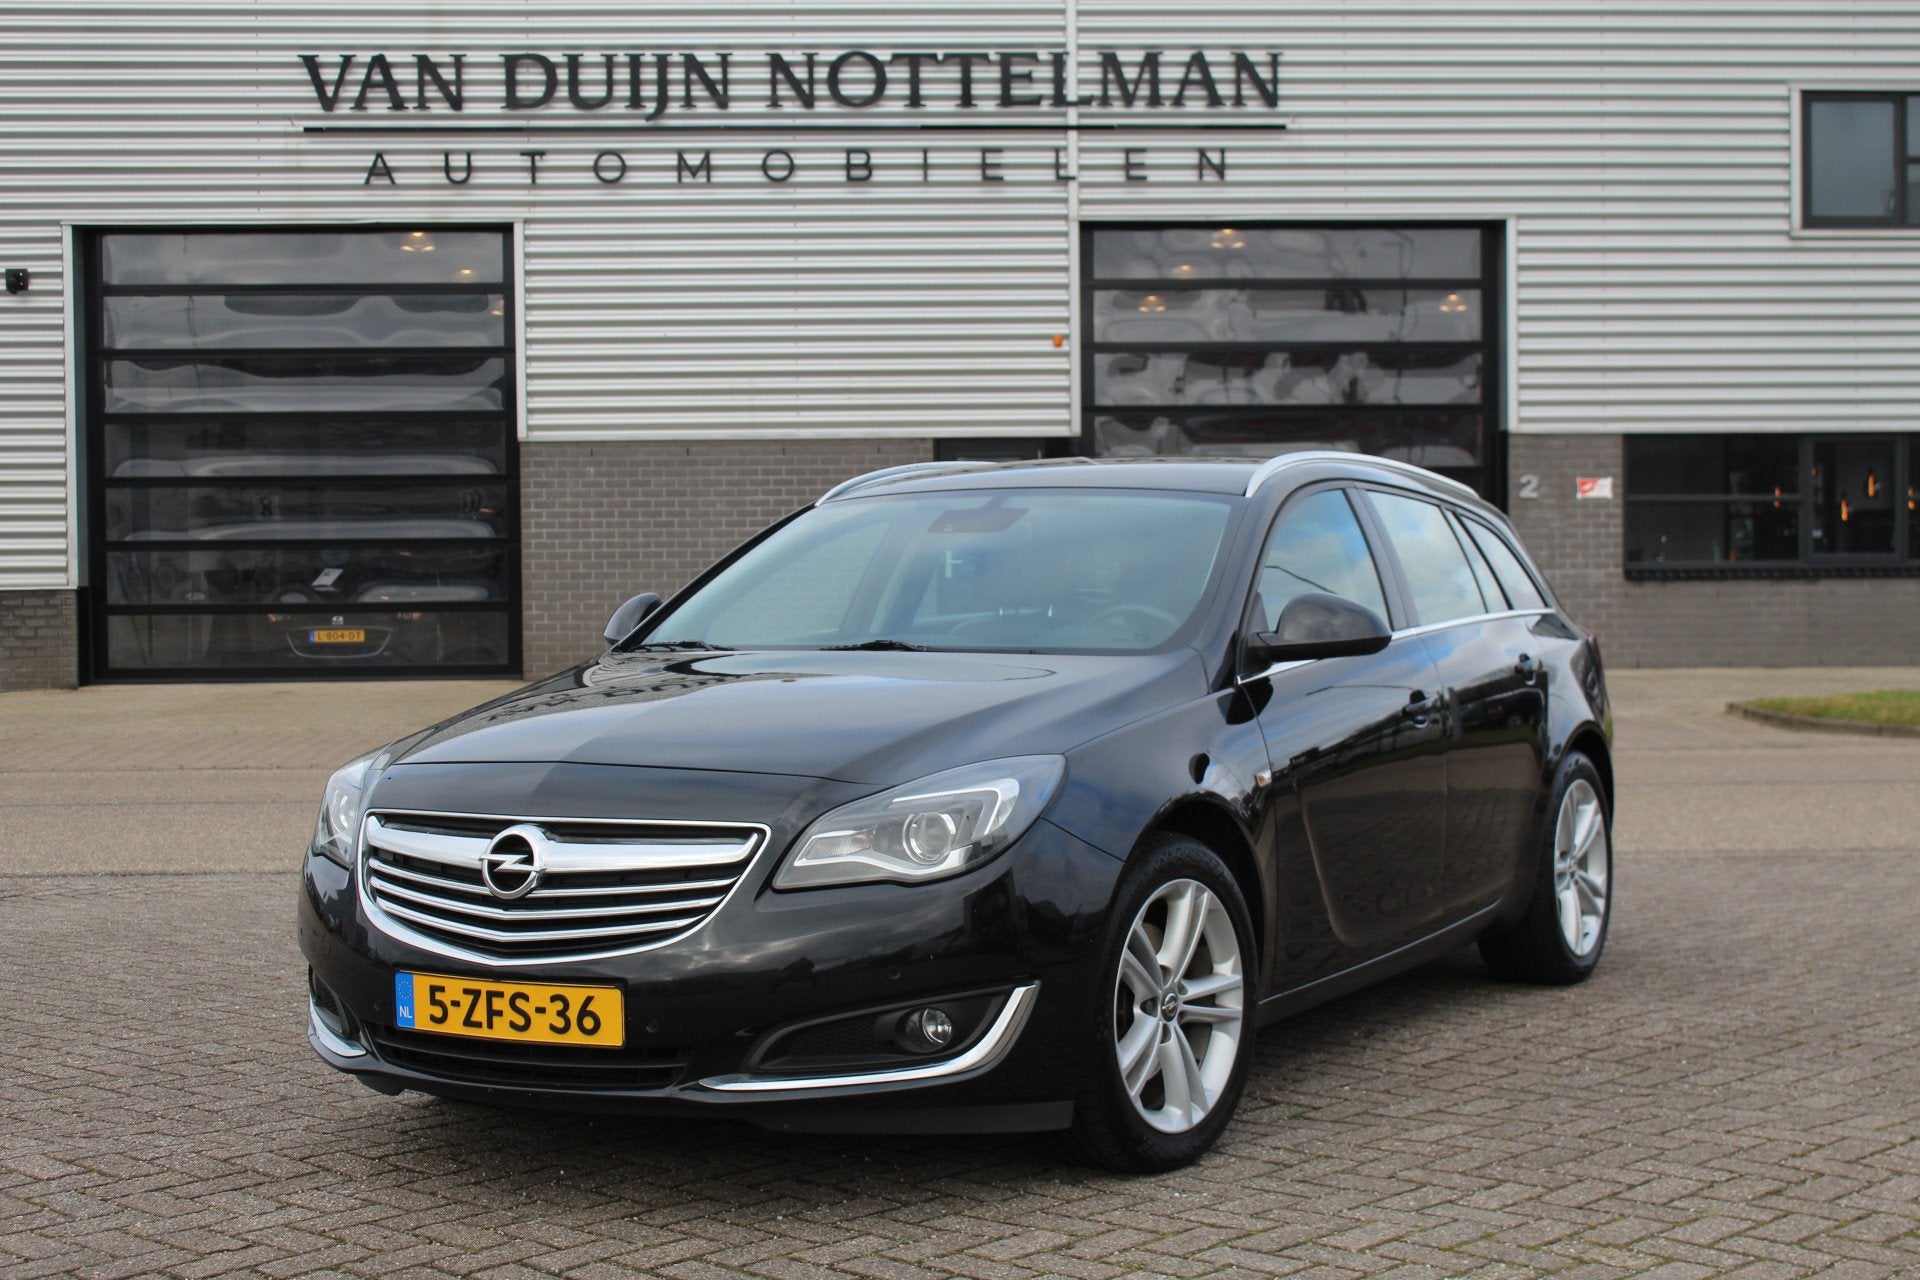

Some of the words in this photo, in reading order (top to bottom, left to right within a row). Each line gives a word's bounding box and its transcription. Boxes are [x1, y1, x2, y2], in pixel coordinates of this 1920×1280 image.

[297, 53, 468, 112] VAN
[499, 52, 733, 122] DUIJN
[764, 50, 1284, 110] NOTTELMAN
[363, 147, 1227, 185] AUTOMOBIELEN
[1518, 473, 1539, 499] 2
[399, 1005, 413, 1019] NL
[428, 984, 602, 1036] 5-ZFS-36
